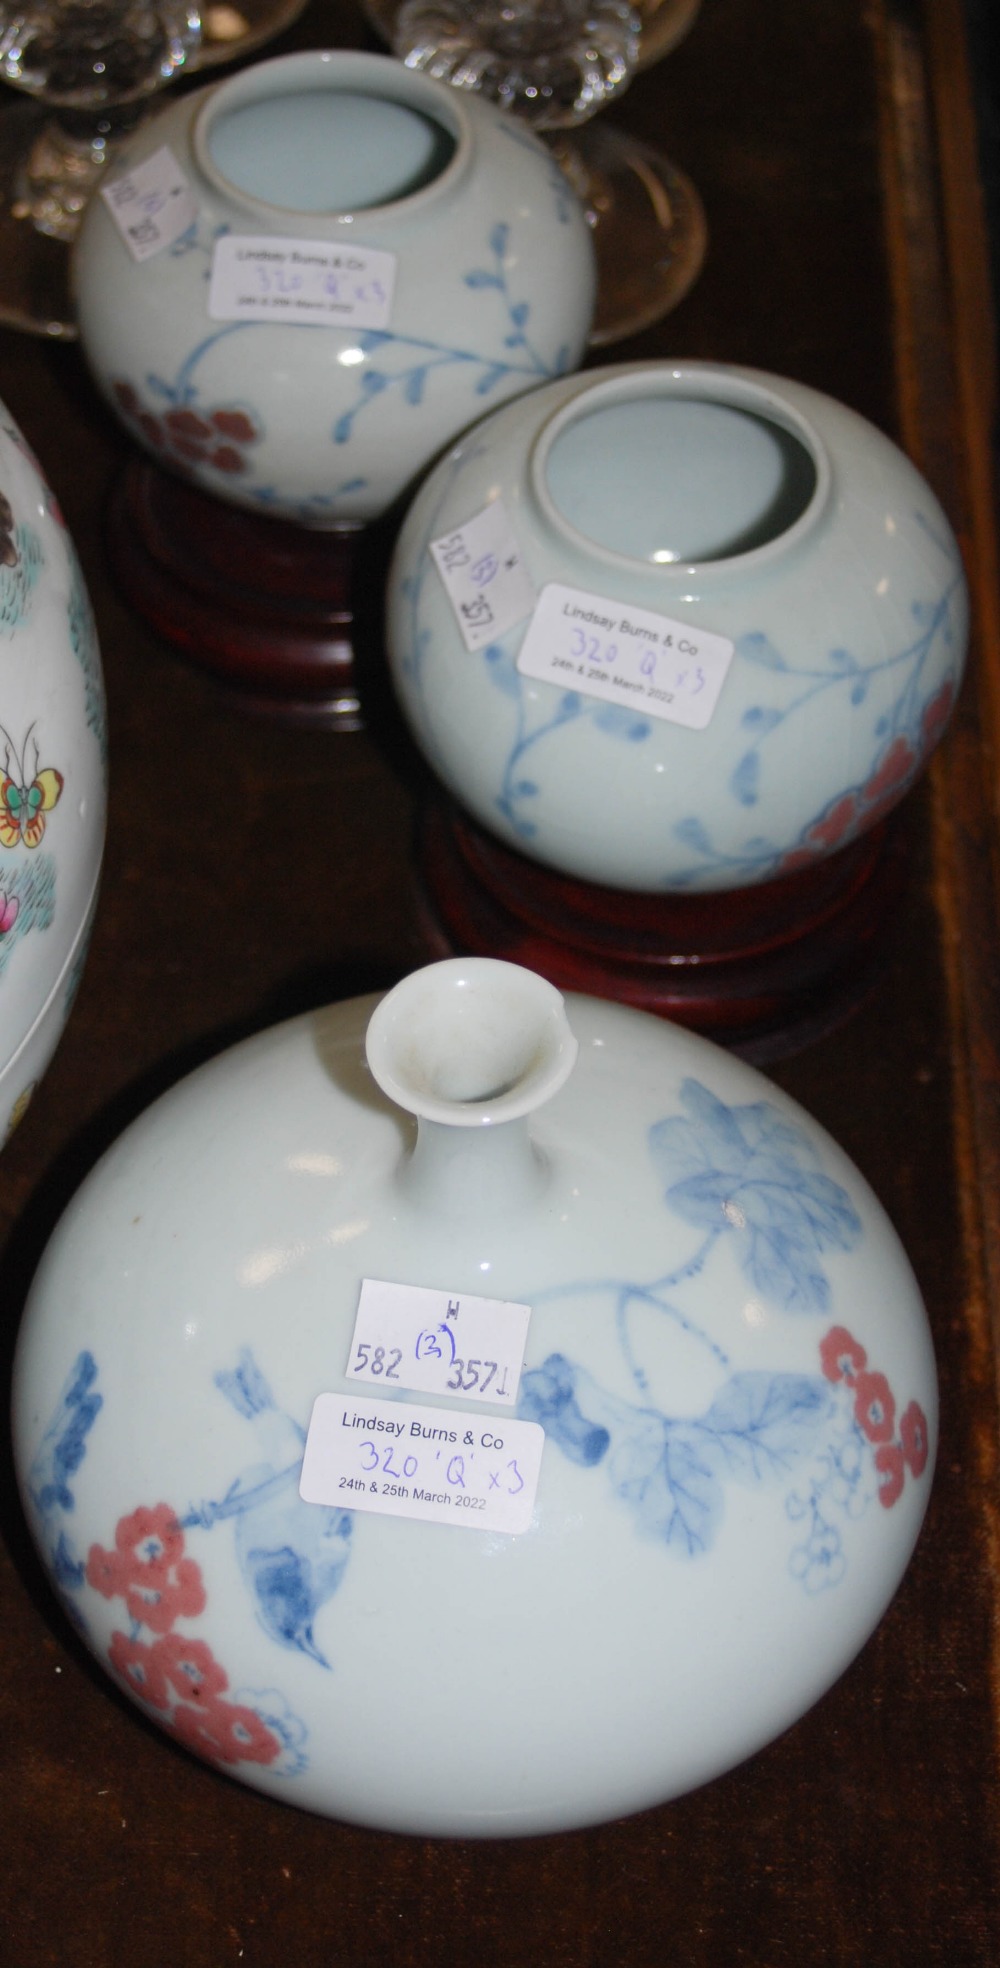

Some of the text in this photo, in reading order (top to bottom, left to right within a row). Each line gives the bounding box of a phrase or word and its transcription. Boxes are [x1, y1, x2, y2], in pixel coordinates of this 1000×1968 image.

[291, 252, 327, 267] Burns
[347, 258, 366, 271] Co
[438, 534, 471, 575] 582
[563, 603, 698, 656] Lindsay Burns & Co
[570, 627, 618, 663] 320
[552, 657, 675, 704] 24th & 25th March 2022
[354, 1344, 402, 1379] 582
[342, 1412, 504, 1450] Lindsay Burns & Co
[359, 1441, 418, 1478] 320
[339, 1477, 487, 1510] 24th & 25th March 2022
